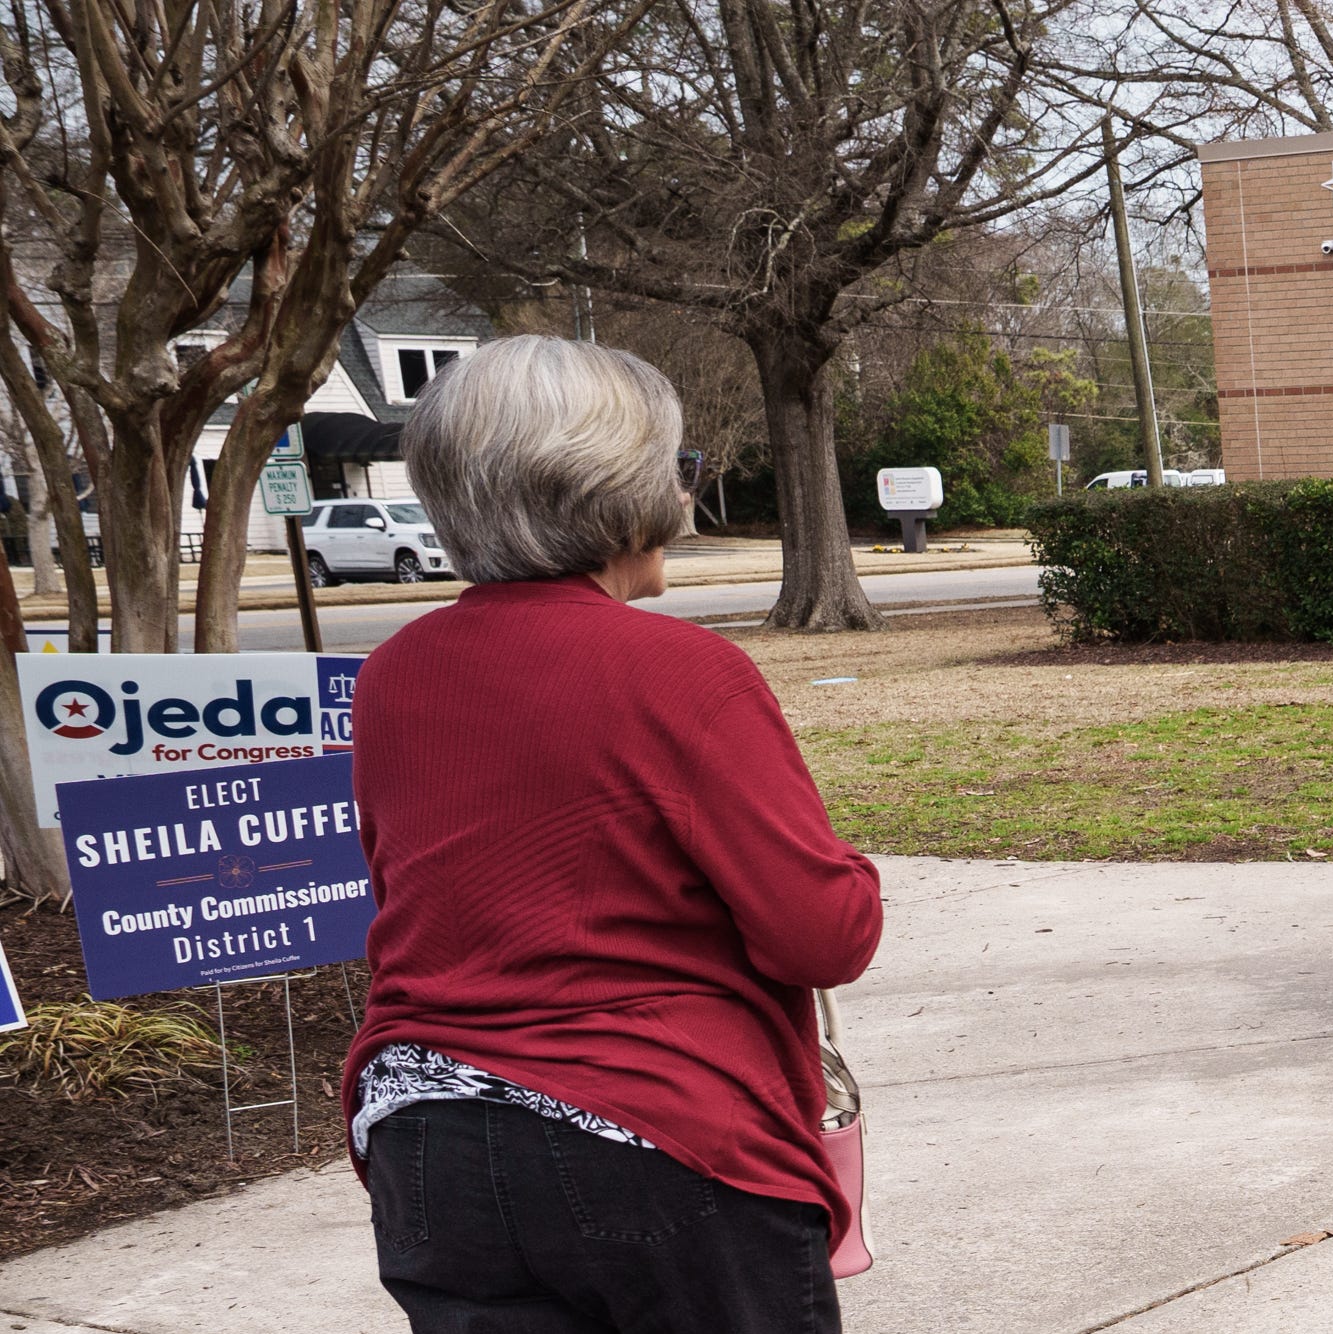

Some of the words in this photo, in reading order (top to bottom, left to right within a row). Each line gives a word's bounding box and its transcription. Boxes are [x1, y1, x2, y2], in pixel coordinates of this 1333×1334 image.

[266, 470, 297, 480] MAXIMUM
[268, 482, 297, 492] PENALTY
[35, 679, 313, 755] Ojeda
[152, 744, 191, 762] for
[197, 744, 314, 763] Congress
[186, 778, 261, 810] ELECT
[76, 820, 222, 867] SHEILA
[103, 903, 193, 936] County
[201, 878, 369, 922] Commissioner
[173, 921, 292, 964] District
[303, 916, 316, 943] 1
